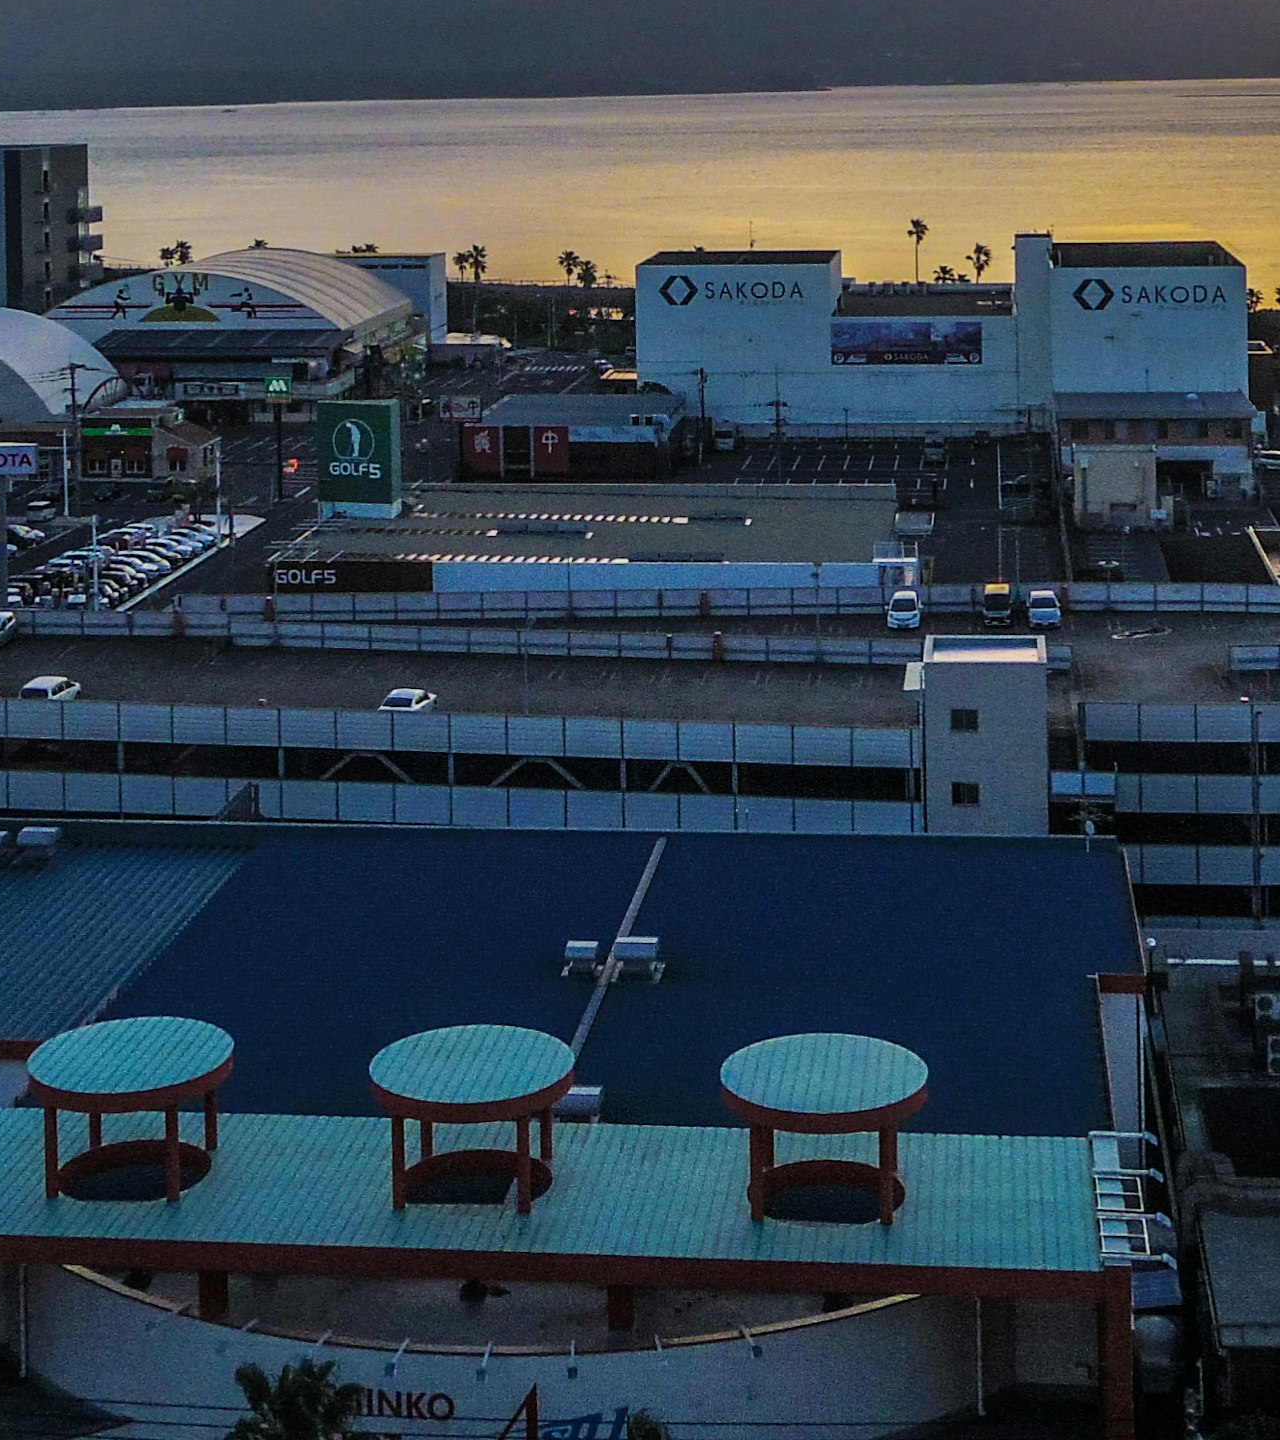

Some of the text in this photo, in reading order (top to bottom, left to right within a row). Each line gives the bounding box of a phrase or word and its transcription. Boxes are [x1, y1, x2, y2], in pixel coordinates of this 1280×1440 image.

[153, 274, 209, 292] GYM
[705, 281, 804, 299] SAKODA
[1121, 285, 1227, 303] SAKODA
[892, 352, 929, 361] SAKODA
[329, 461, 382, 479] GOLF5
[275, 569, 337, 585] GOLF5
